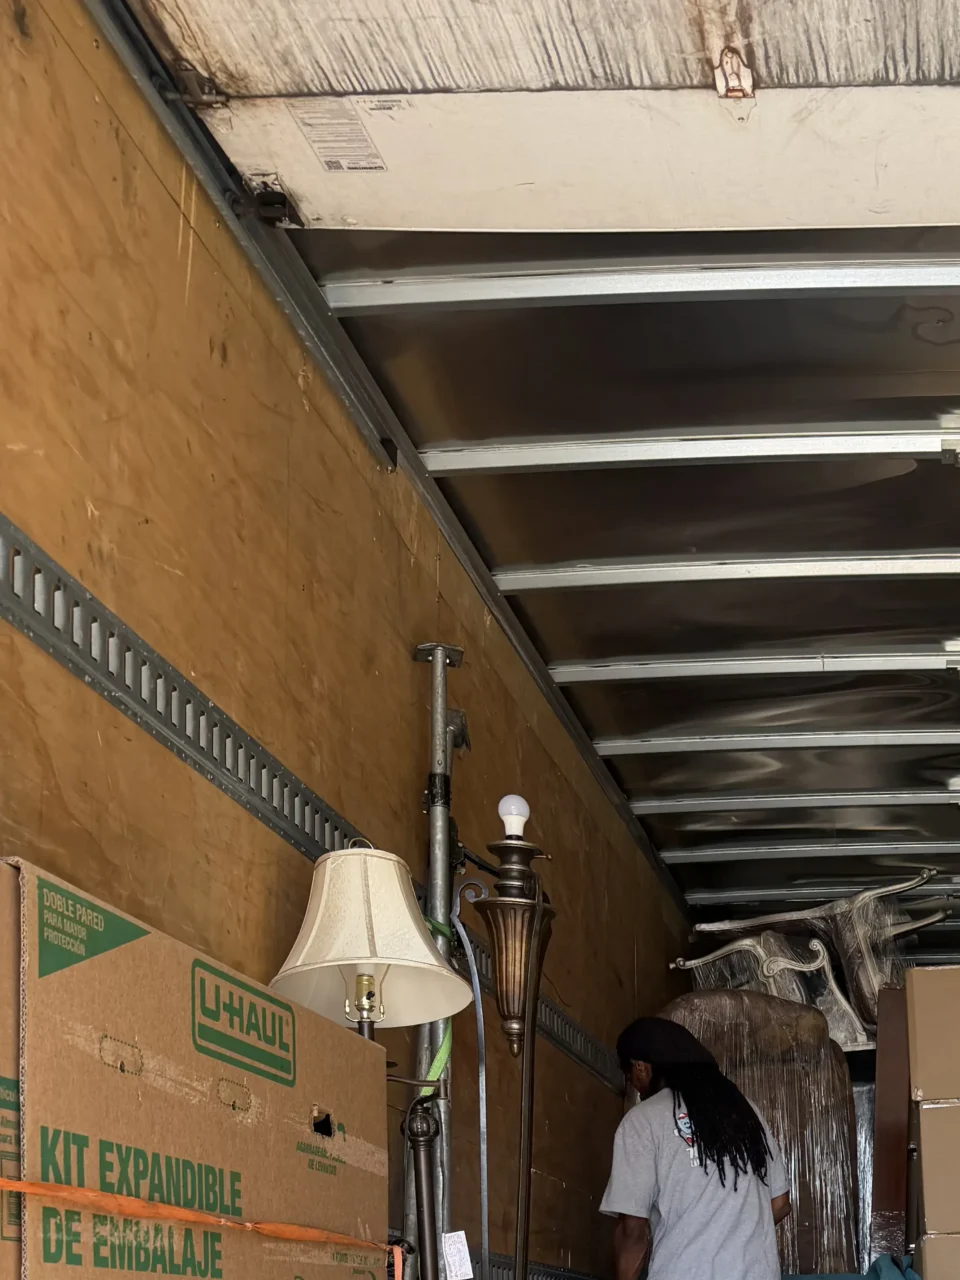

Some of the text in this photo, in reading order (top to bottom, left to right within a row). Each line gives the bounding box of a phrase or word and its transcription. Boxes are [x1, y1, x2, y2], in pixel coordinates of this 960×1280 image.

[43, 888, 104, 931] DOBLE PARED
[43, 909, 87, 940] PARA MAYOR
[43, 927, 85, 956] PROTECCIÓN
[40, 1125, 89, 1187] KIT
[98, 1138, 243, 1217] EXPANDIBLE
[42, 1206, 223, 1279] DE EMBALAJE
